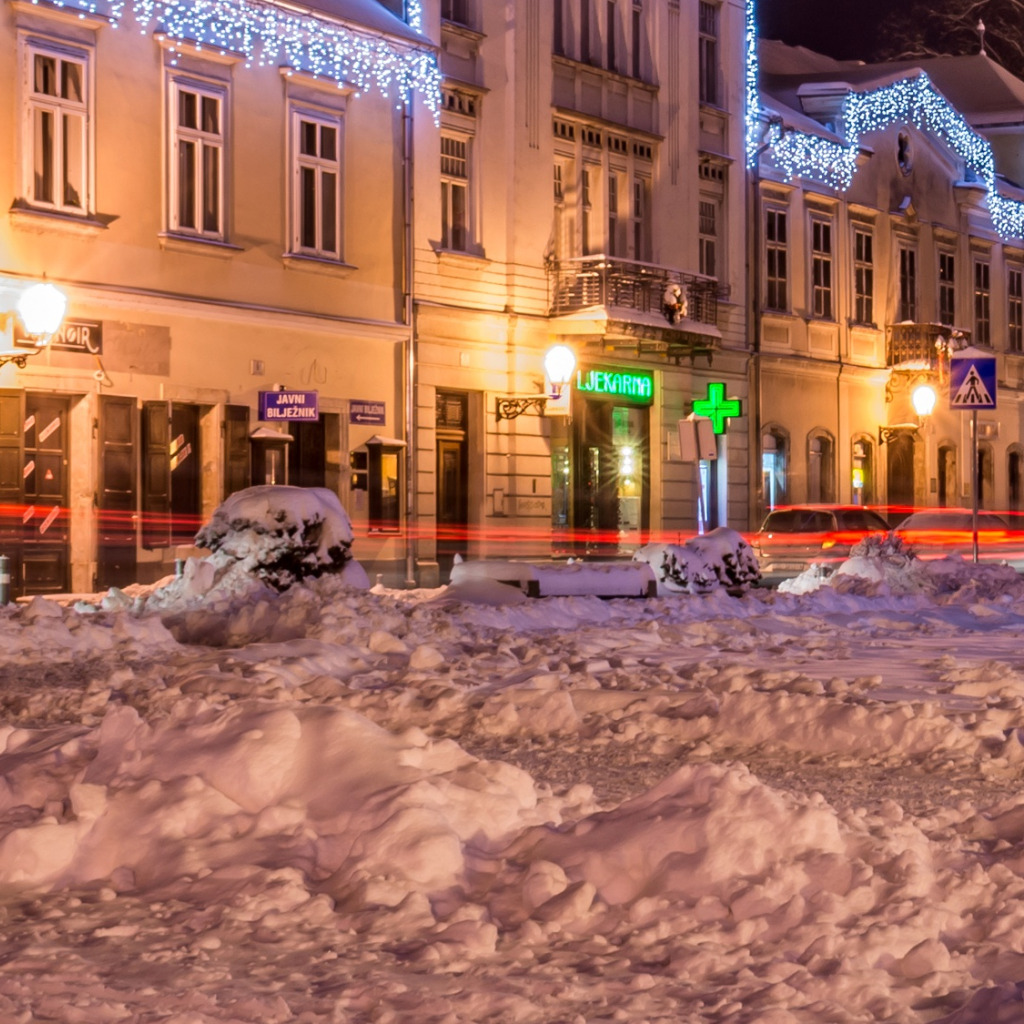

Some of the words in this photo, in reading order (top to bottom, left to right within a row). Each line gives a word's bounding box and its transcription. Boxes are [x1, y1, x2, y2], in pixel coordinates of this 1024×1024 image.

[577, 369, 651, 397] LJEKARNA
[276, 394, 305, 404] JAVNI
[266, 405, 316, 418] BILJEŽNIK
